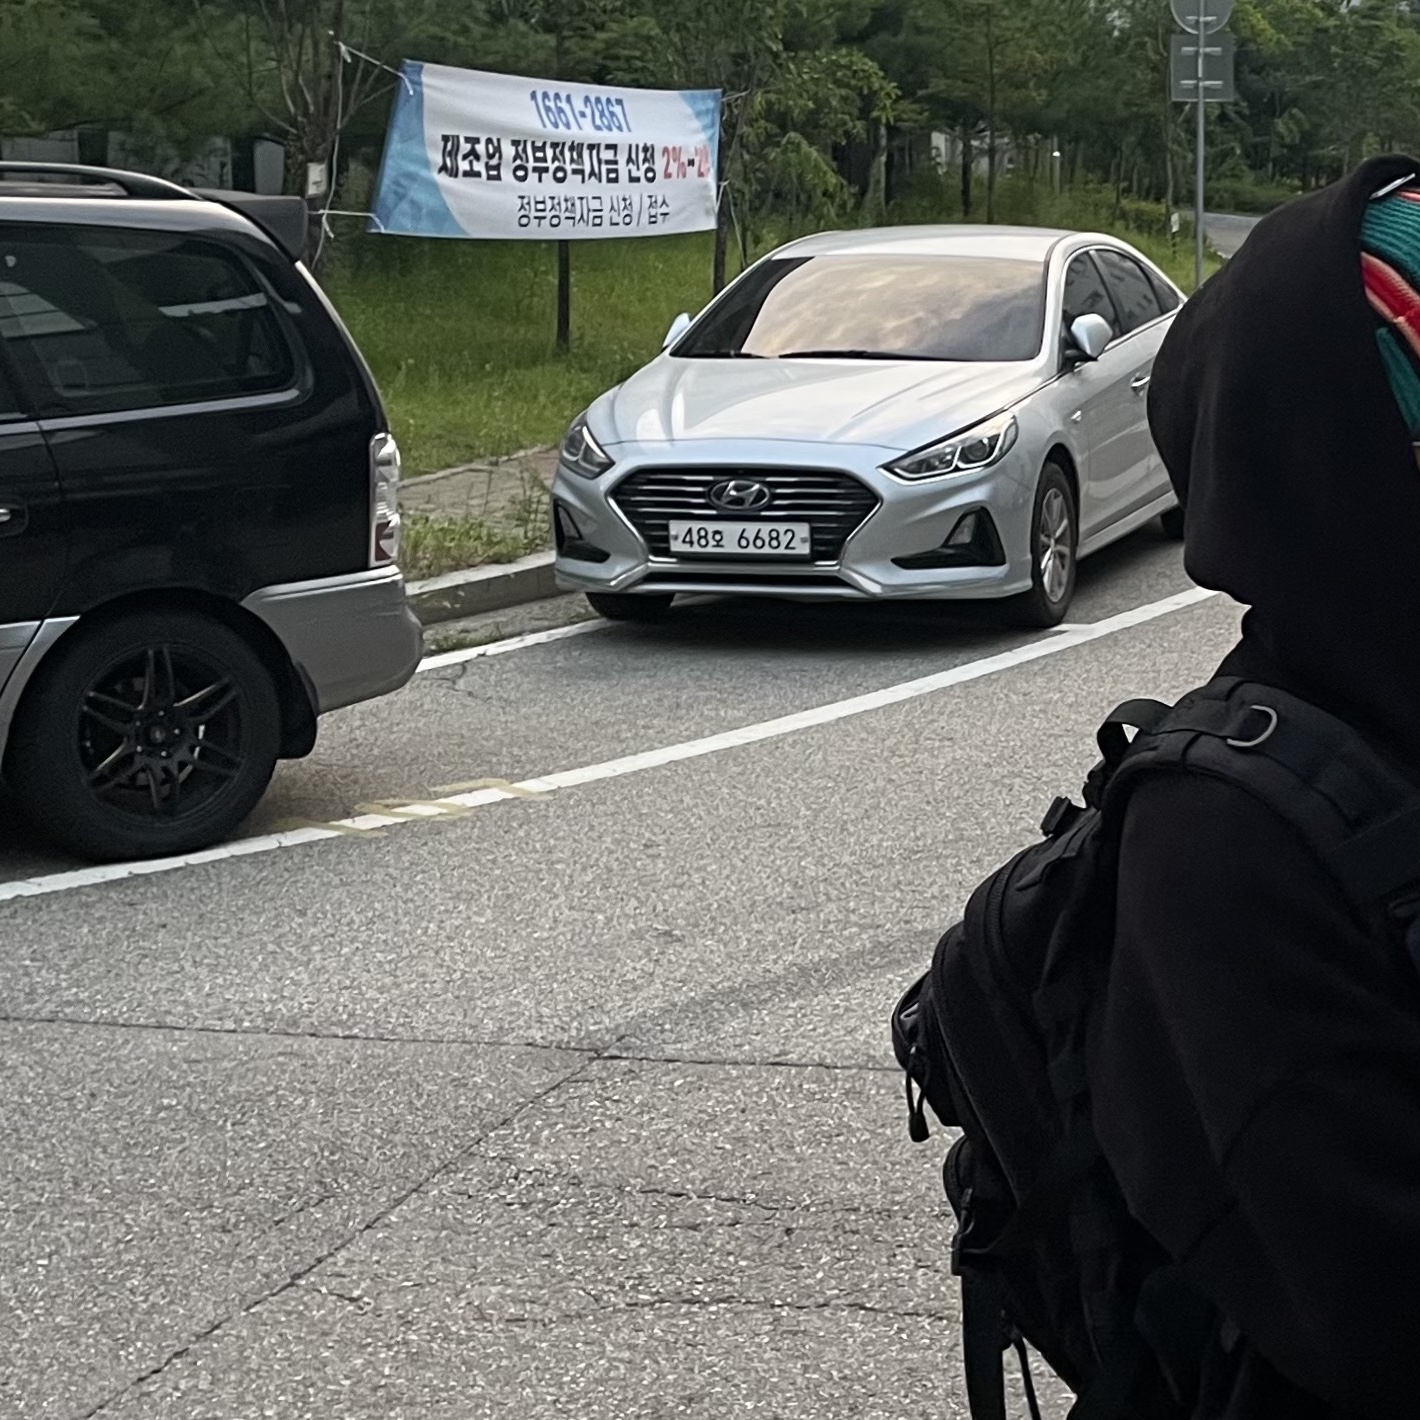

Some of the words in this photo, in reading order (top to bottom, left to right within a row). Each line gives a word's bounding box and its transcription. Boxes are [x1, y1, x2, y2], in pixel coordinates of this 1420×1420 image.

[530, 90, 632, 132] 1661-2867
[437, 134, 503, 181] 제조업
[511, 139, 619, 184] 정부정책자금
[626, 142, 657, 184] 신청
[517, 195, 603, 228] 정부정책자금
[609, 194, 633, 227] 신청
[647, 194, 670, 225] 접수
[737, 528, 797, 550] 6682
